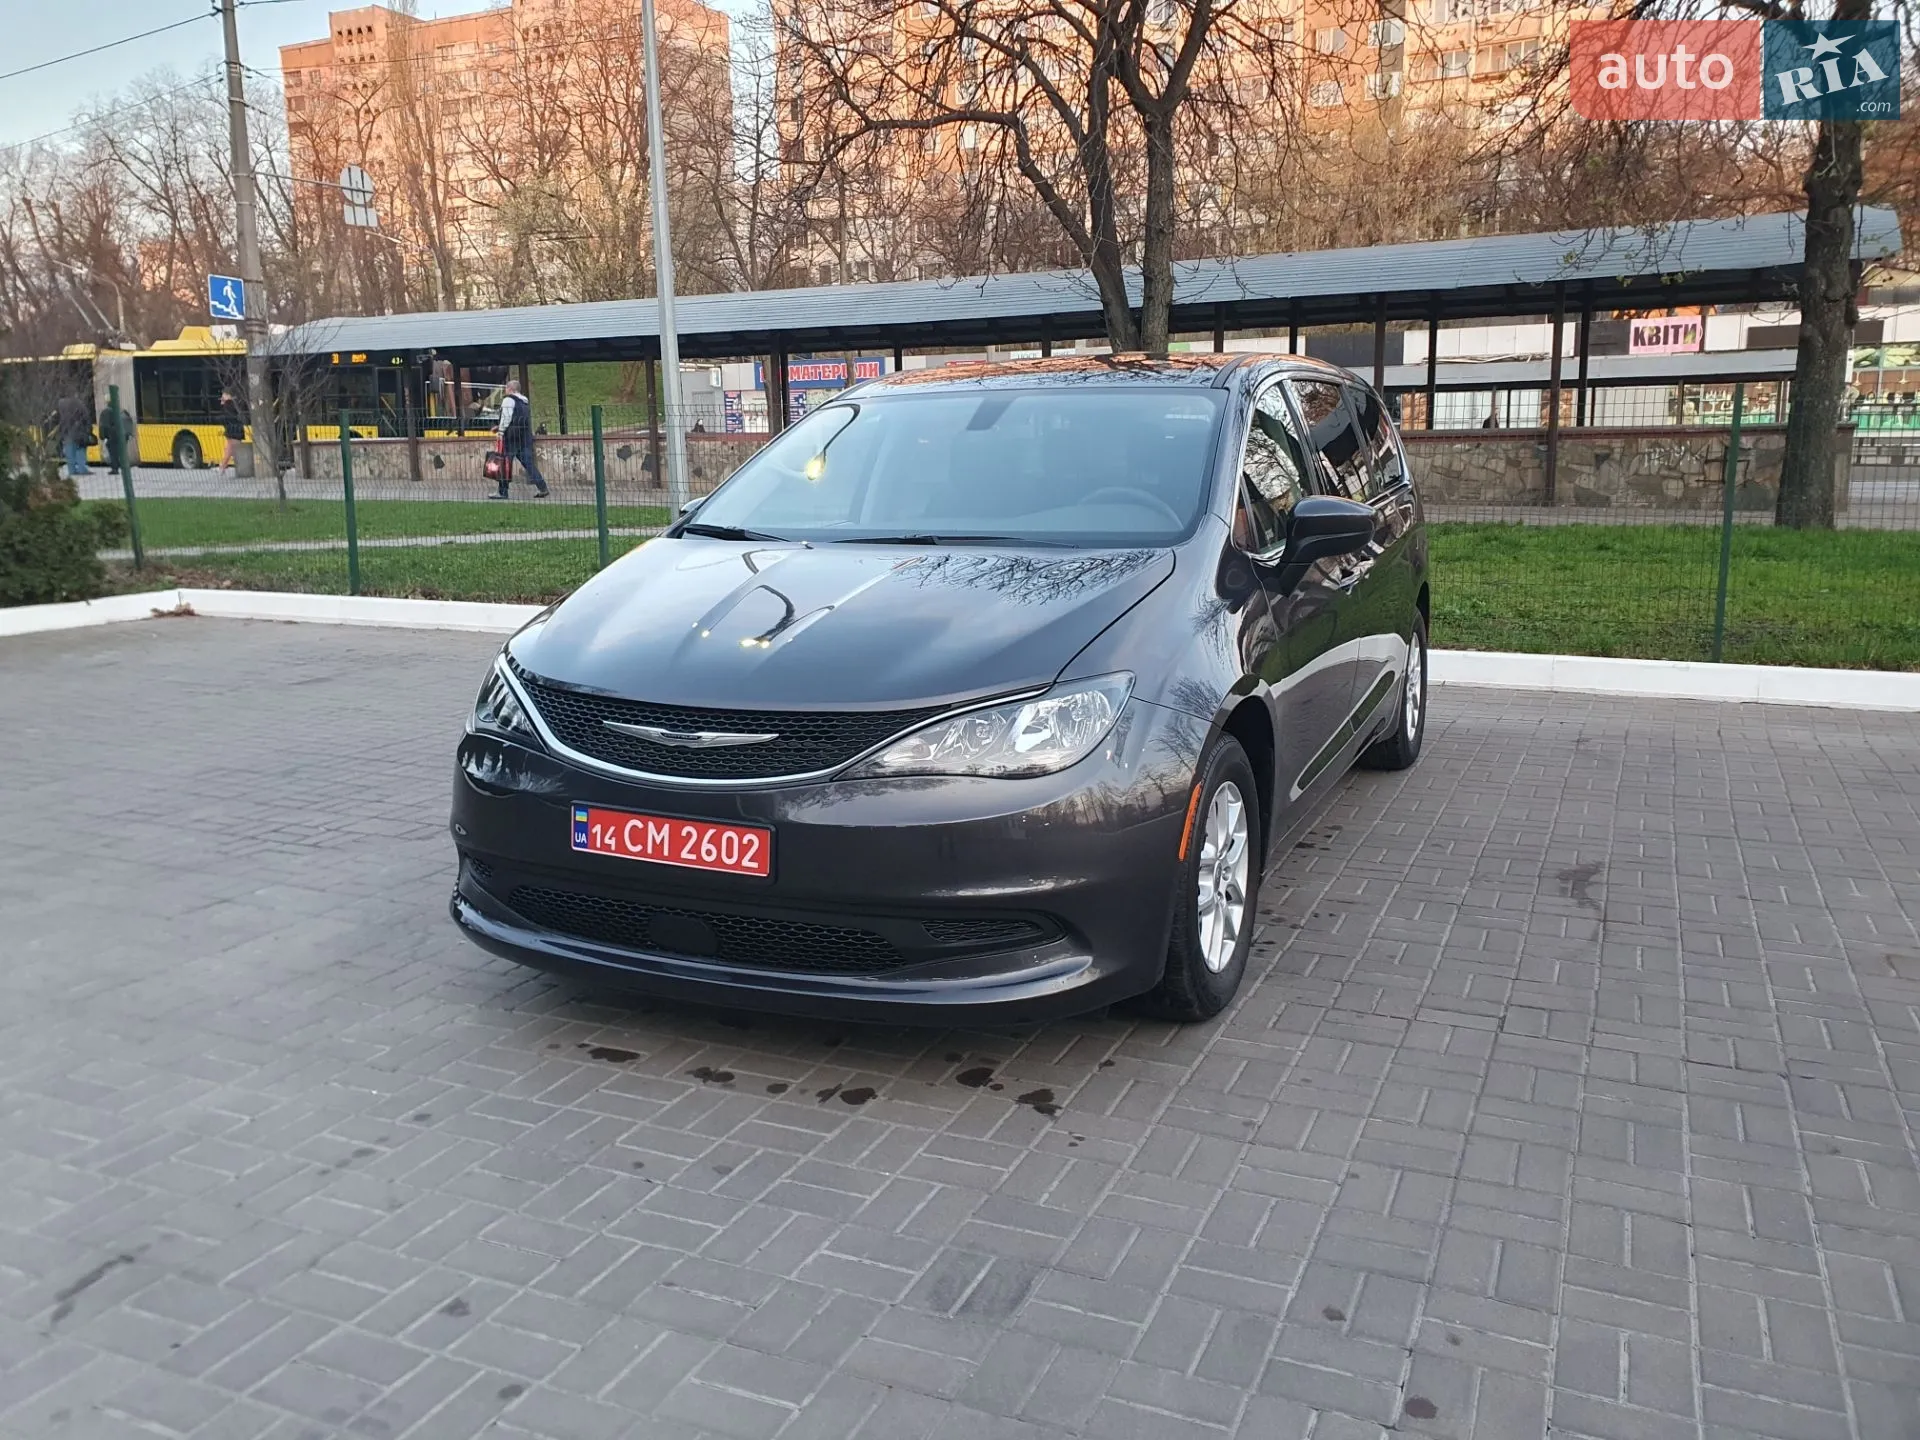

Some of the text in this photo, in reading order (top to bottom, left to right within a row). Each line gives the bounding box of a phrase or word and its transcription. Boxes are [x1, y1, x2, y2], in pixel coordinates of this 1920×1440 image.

[1633, 323, 1698, 347] КВІТИ
[575, 832, 587, 844] UA
[680, 826, 761, 869] 2602
